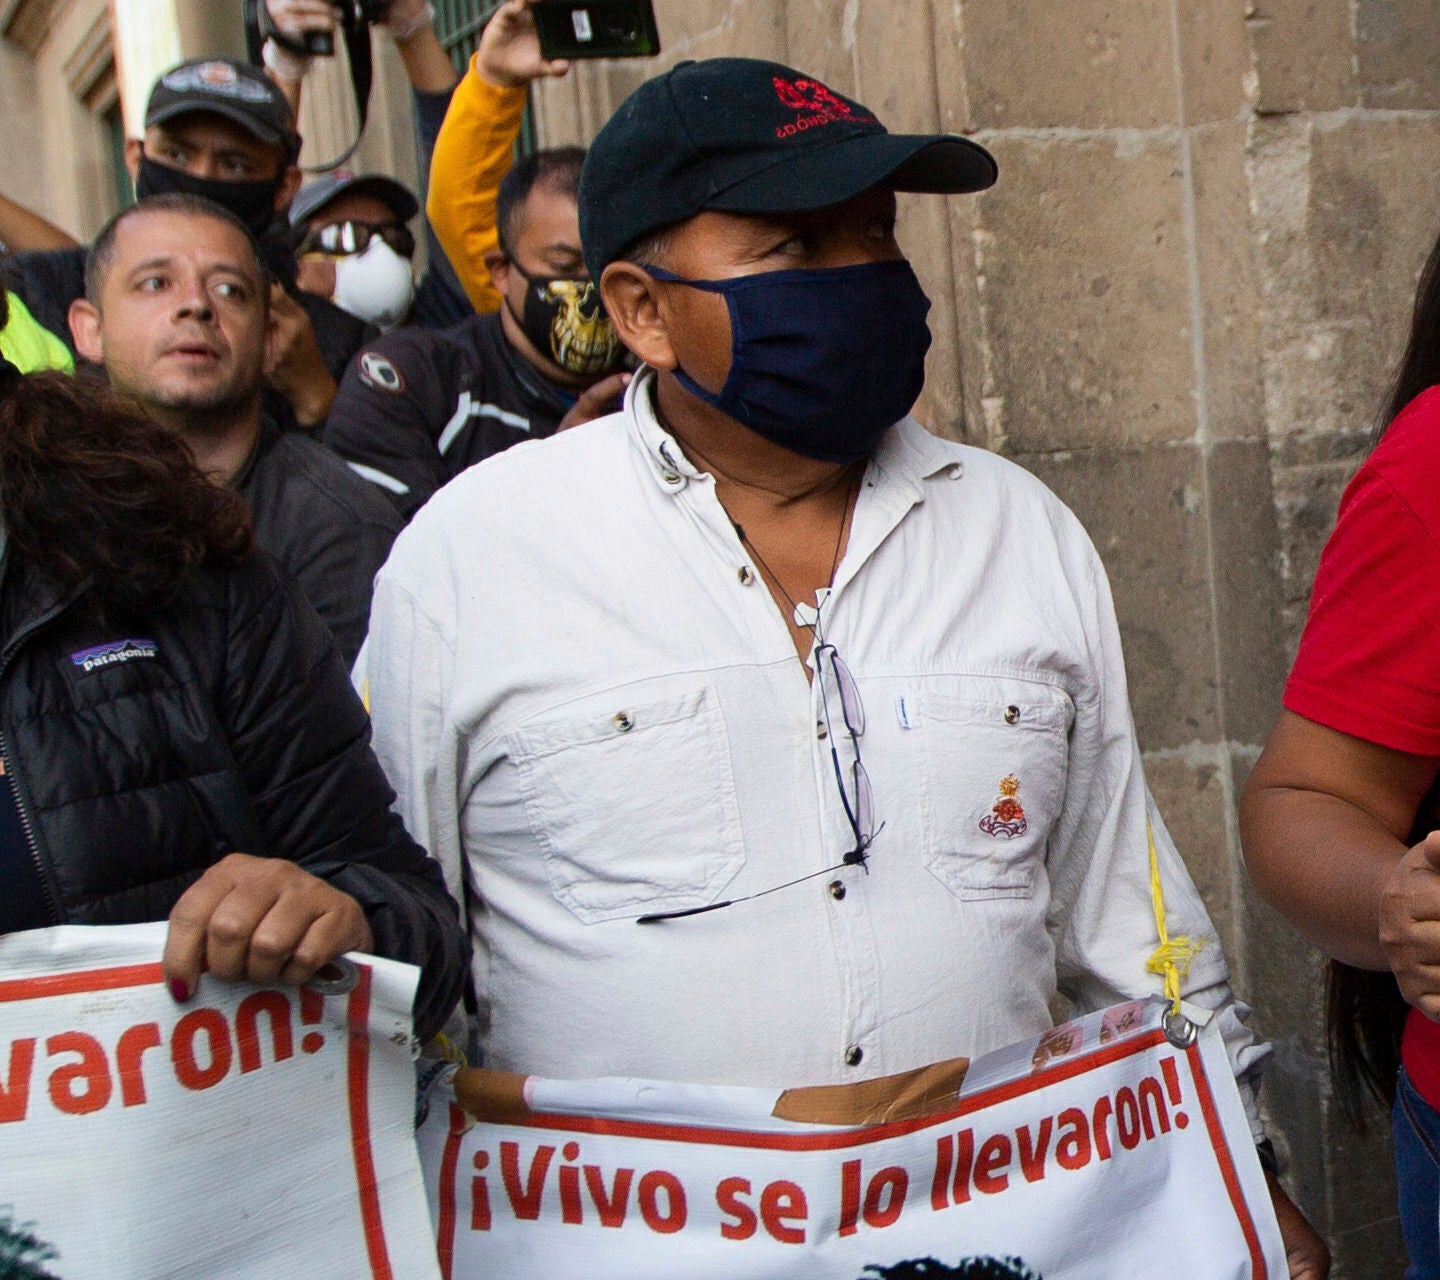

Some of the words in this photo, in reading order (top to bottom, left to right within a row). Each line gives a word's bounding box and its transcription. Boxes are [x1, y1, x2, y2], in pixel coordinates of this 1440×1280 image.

[83, 647, 157, 671] patagonia
[470, 1140, 689, 1235] ¡Vivo
[714, 1175, 810, 1245] se
[837, 1158, 910, 1239] lo
[929, 1055, 1191, 1212] llevaron!
